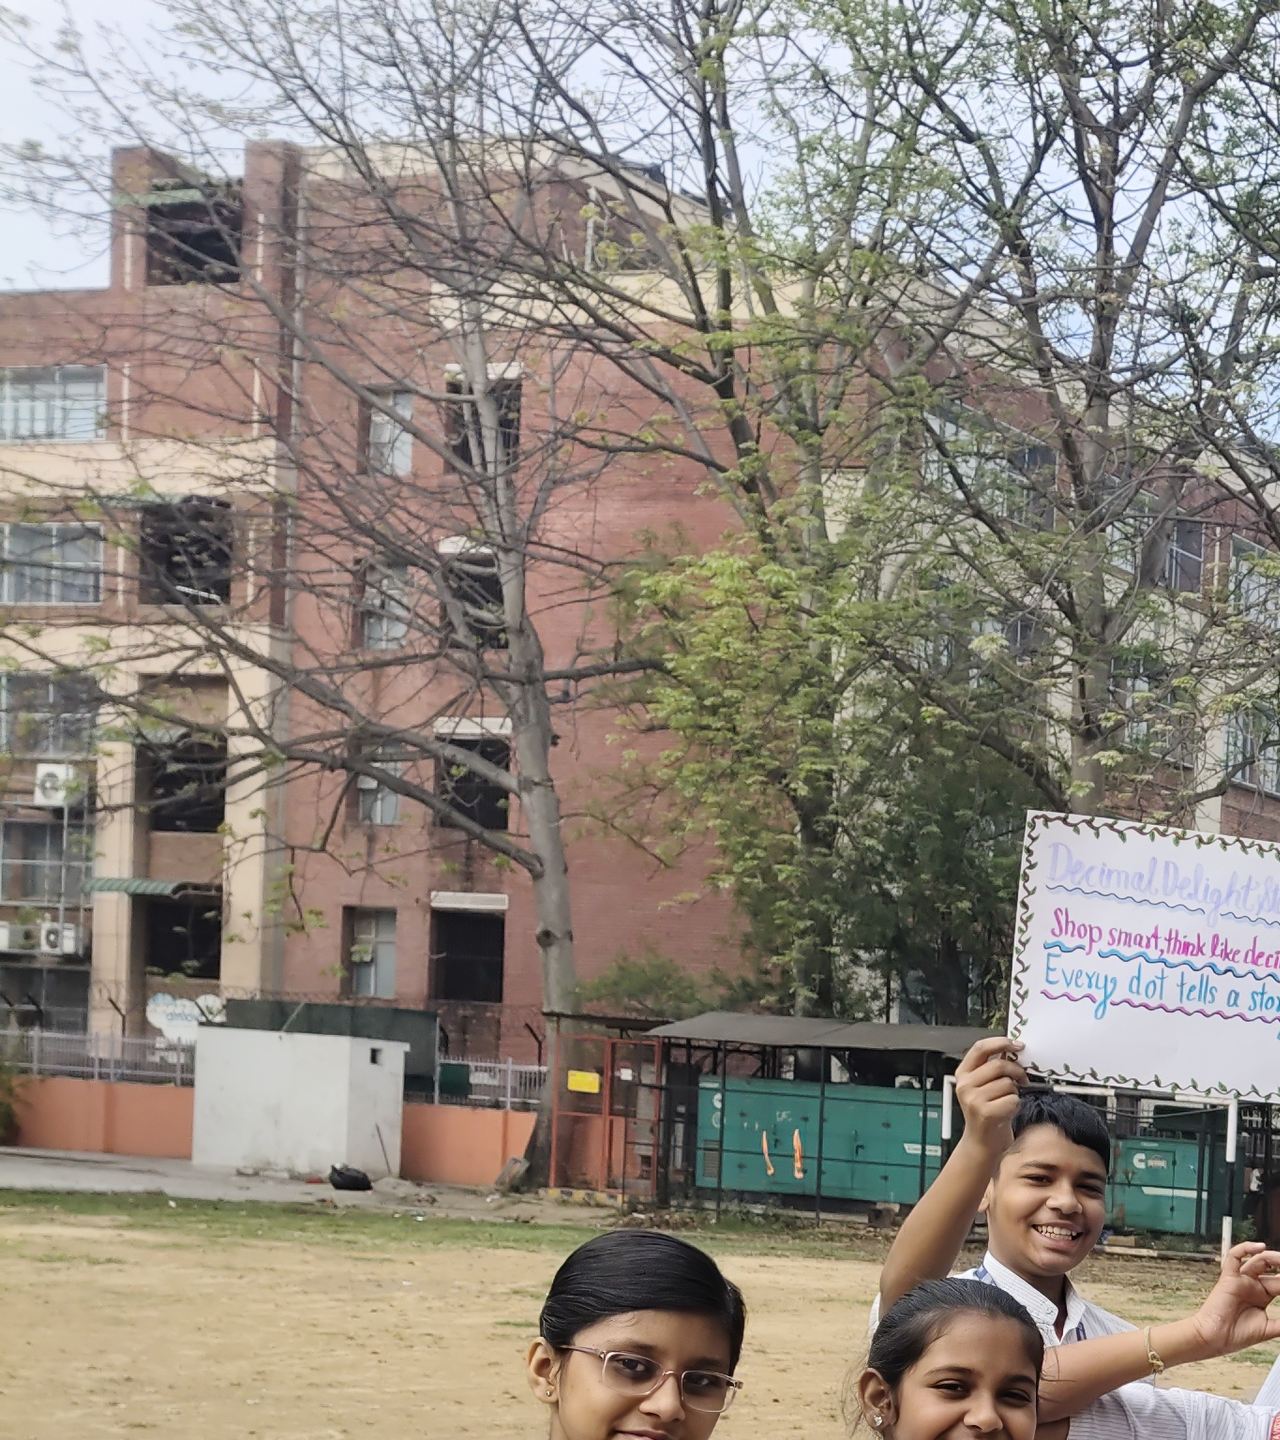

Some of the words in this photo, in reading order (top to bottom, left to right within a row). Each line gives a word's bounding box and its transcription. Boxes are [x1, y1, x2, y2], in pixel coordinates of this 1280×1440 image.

[1047, 841, 1157, 895] Decimal
[1163, 860, 1251, 927] Delight
[1051, 908, 1101, 955] Shop
[1164, 929, 1206, 957] think
[1211, 934, 1240, 964] like
[1045, 953, 1116, 1019] Every
[1129, 963, 1168, 1000] dot
[1177, 973, 1218, 1007] tells
[1227, 988, 1239, 1008] a
